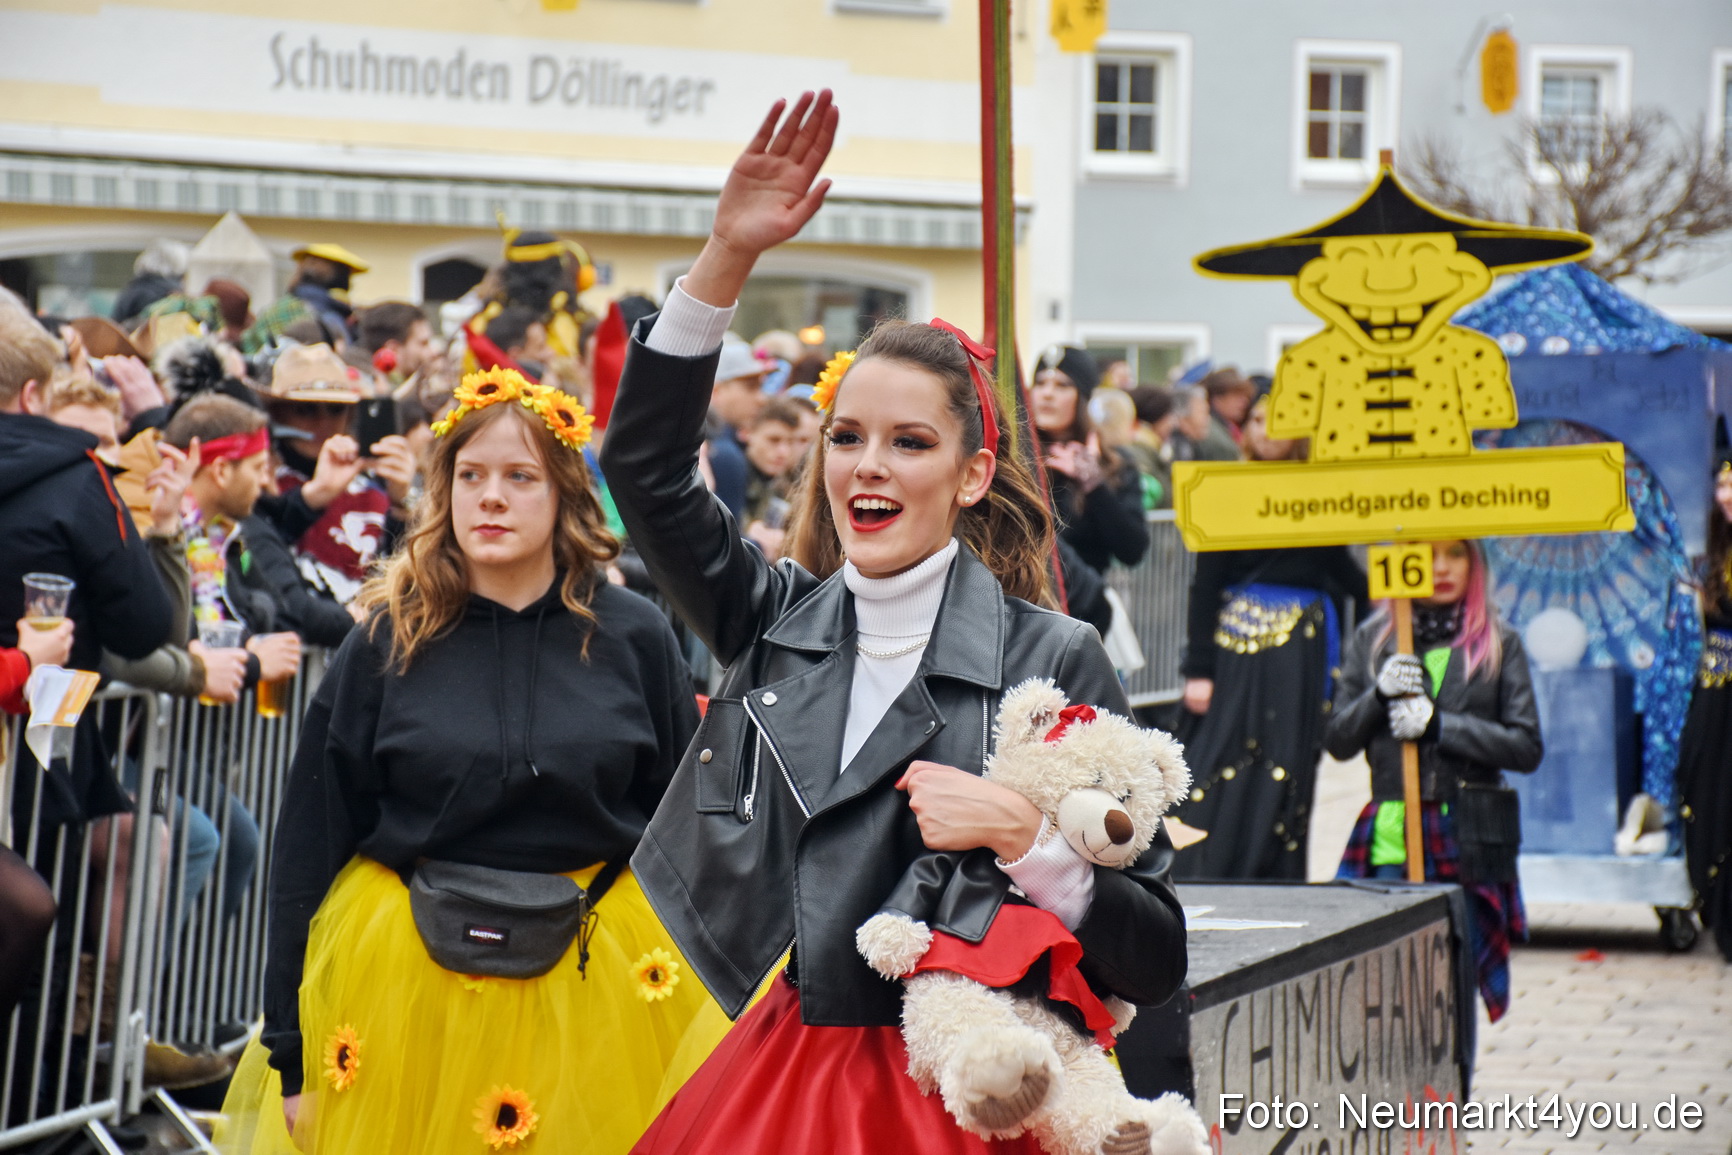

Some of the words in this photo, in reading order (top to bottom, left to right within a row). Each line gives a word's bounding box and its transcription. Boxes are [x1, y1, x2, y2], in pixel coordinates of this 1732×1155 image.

[269, 31, 511, 102] Schuhmoden
[527, 54, 716, 124] Döllinger
[1257, 489, 1431, 520] Jugendgarde
[1440, 484, 1551, 510] Deching
[1374, 554, 1424, 588] 16
[469, 929, 503, 941] EASTPAK
